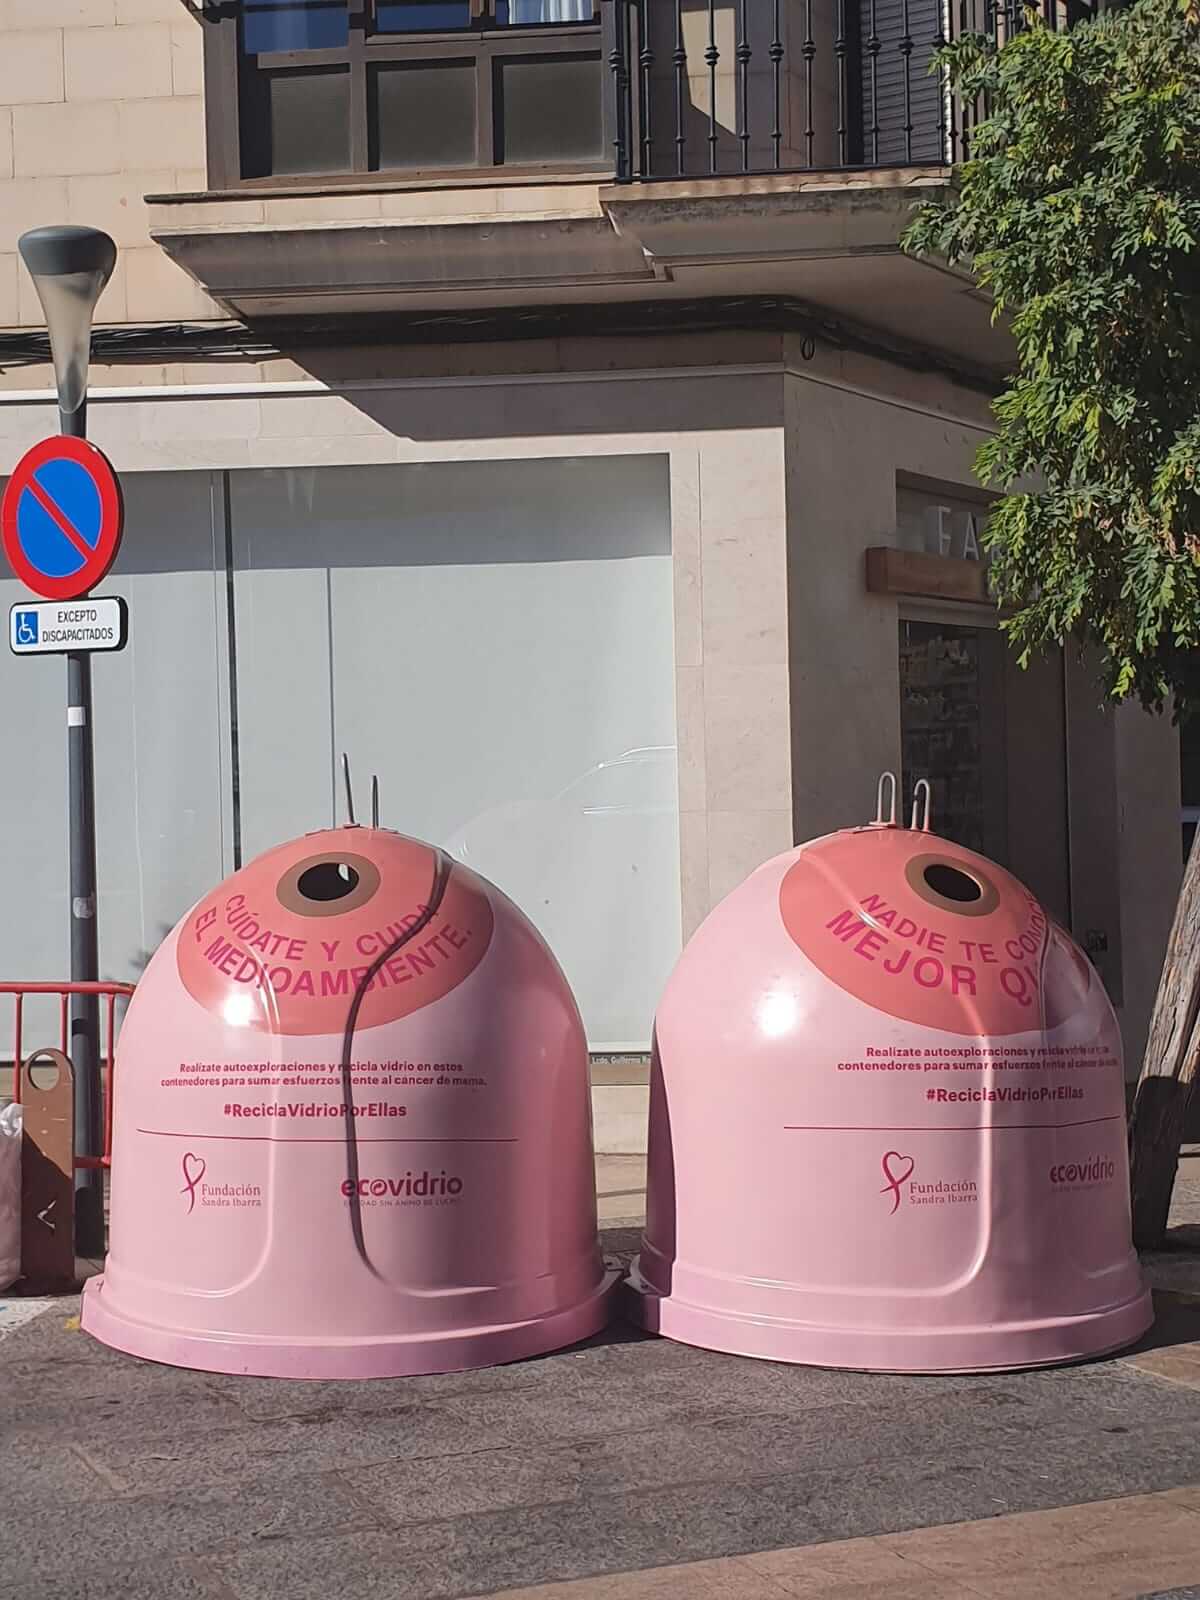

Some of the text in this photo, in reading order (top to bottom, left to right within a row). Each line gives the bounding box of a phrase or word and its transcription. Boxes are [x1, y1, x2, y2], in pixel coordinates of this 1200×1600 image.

[57, 609, 97, 623] EXCEPTO
[42, 627, 114, 642] DISCAPACITADOS
[225, 894, 307, 961] CUÍDATE
[320, 940, 341, 962] Y
[859, 894, 946, 954] NADIE
[959, 940, 1000, 963] TE
[195, 906, 473, 997] EL MEDIOAMBIENTE.
[826, 909, 977, 996] MEJOR
[924, 1045, 1028, 1058] autoexploraciones
[1029, 1048, 1036, 1058] y
[223, 1061, 326, 1073] autoexploraciones
[328, 1063, 336, 1074] y
[380, 1060, 415, 1071] vidrio
[417, 1063, 432, 1071] en
[433, 1062, 463, 1072] estos
[838, 1061, 921, 1071] contenedores
[924, 1062, 950, 1072] para
[953, 1061, 989, 1070] sumar
[992, 1059, 1041, 1071] esfuerzos
[161, 1075, 220, 1086] contenedores
[222, 1078, 245, 1087] para
[247, 1077, 280, 1085] sumar
[283, 1075, 340, 1085] esfuerzos
[382, 1074, 392, 1085] al
[436, 1074, 451, 1085] de
[224, 1102, 407, 1117] #ReciclaVidrioPorEllas
[1050, 1155, 1115, 1184] ecovidrio
[201, 1182, 261, 1196] Fundación
[341, 1170, 463, 1197] ecovidrio
[910, 1180, 977, 1194] Fundación
[201, 1197, 261, 1207] Sandra Ibarra
[910, 1193, 978, 1204] Sandra Ibarra
